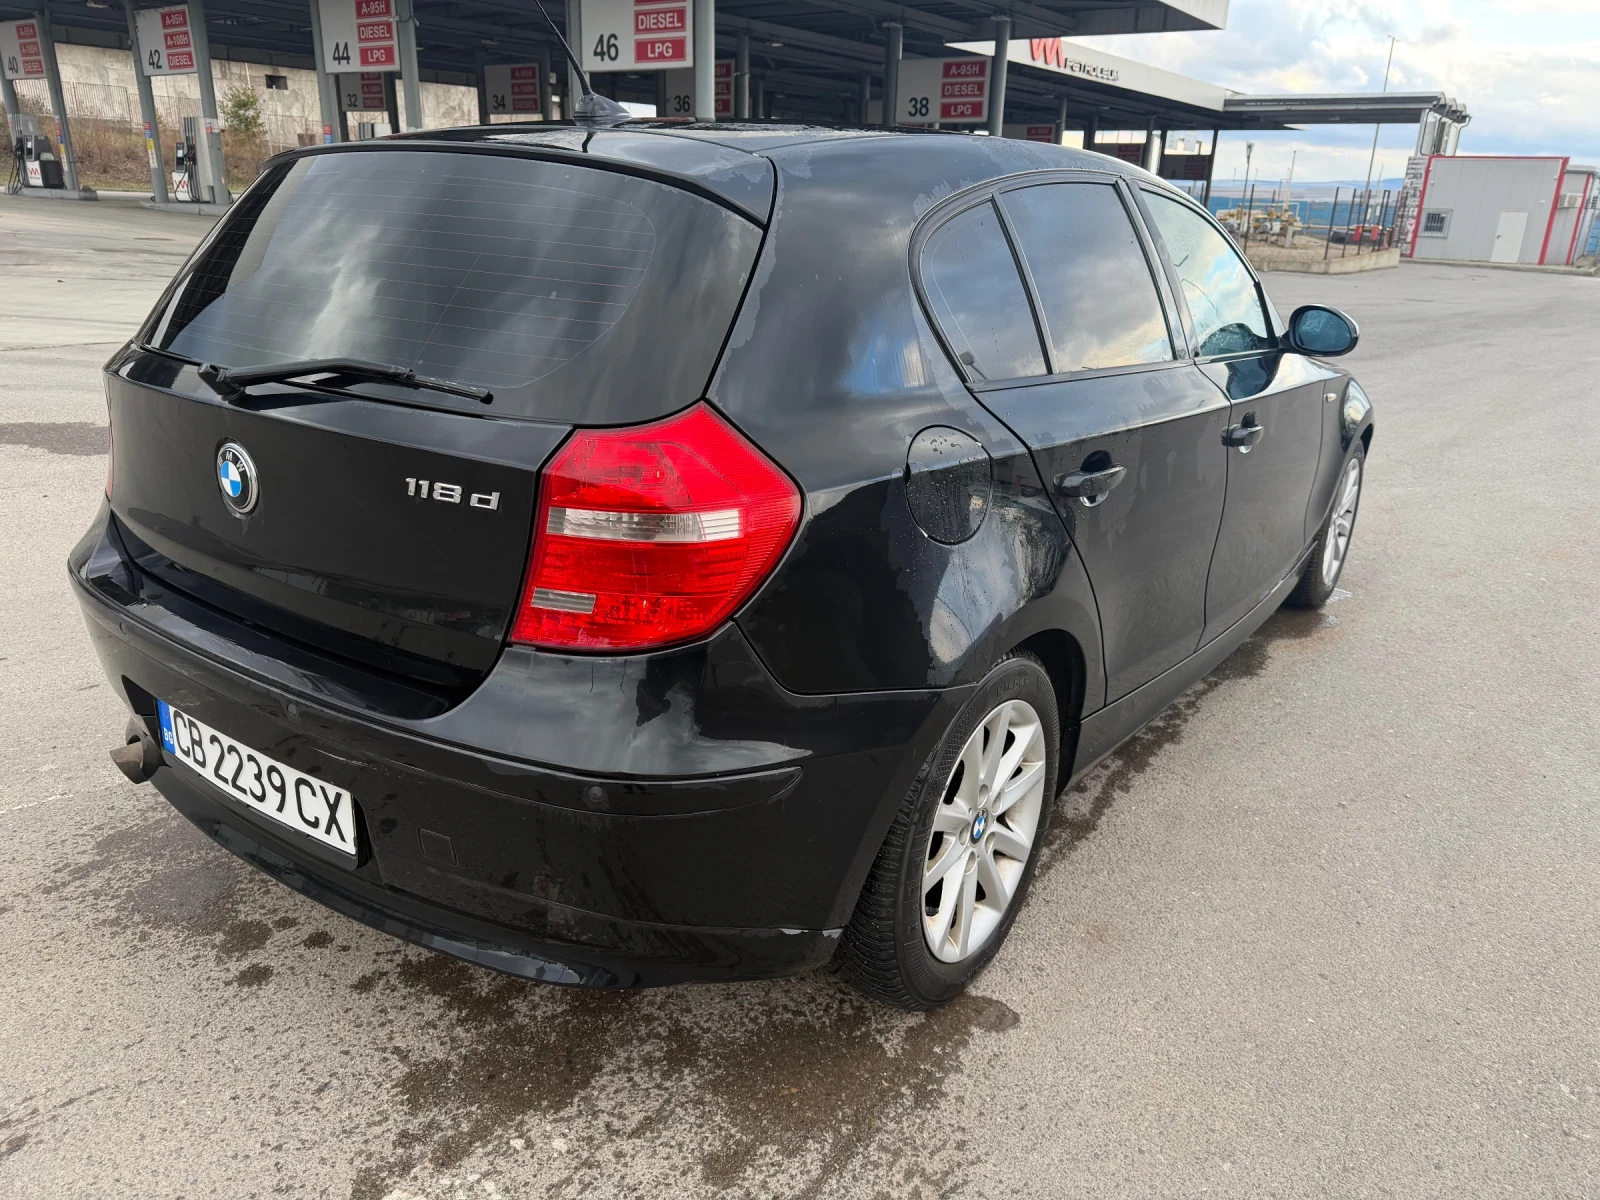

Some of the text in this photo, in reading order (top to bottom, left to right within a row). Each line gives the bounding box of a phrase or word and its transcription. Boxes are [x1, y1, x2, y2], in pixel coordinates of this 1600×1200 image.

[361, 1, 386, 14] A-95H
[165, 14, 184, 26] A-95H
[638, 12, 682, 30] DIESEL
[360, 25, 390, 39] DIESEL
[167, 34, 189, 47] A-100H
[593, 33, 619, 62] 46
[333, 41, 350, 65] 44
[367, 49, 386, 62] LPG
[647, 42, 673, 58] LPG
[8, 56, 18, 74] 40
[148, 49, 162, 69] 42
[168, 54, 191, 66] DIESEL
[950, 64, 980, 76] A-95H
[944, 84, 980, 96] DIESEL
[347, 93, 358, 108] 32
[492, 94, 506, 110] 34
[674, 95, 691, 112] 36
[908, 97, 929, 117] 38
[951, 104, 972, 116] LPG
